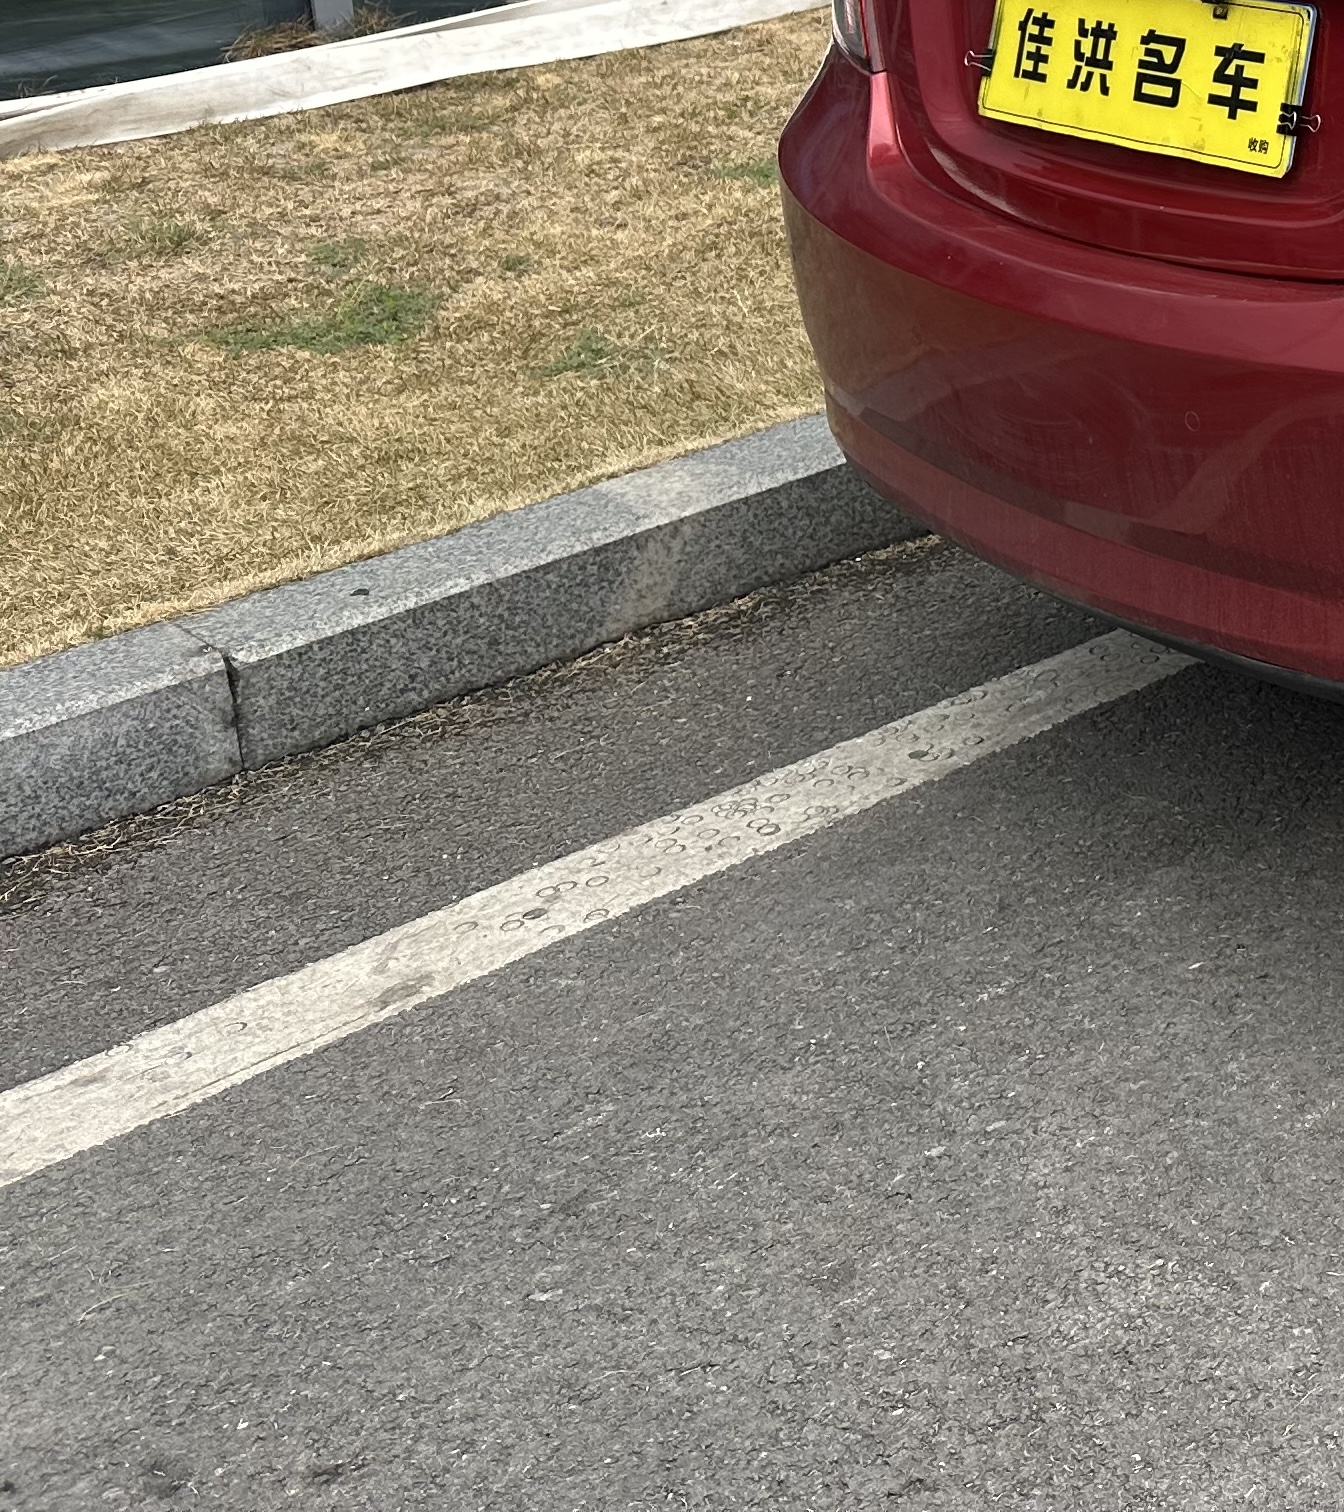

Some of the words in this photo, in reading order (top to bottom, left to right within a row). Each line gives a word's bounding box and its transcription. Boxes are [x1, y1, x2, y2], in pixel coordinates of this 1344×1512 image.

[1013, 7, 1266, 120] 佳洪名车
[1247, 136, 1270, 155] 收购
